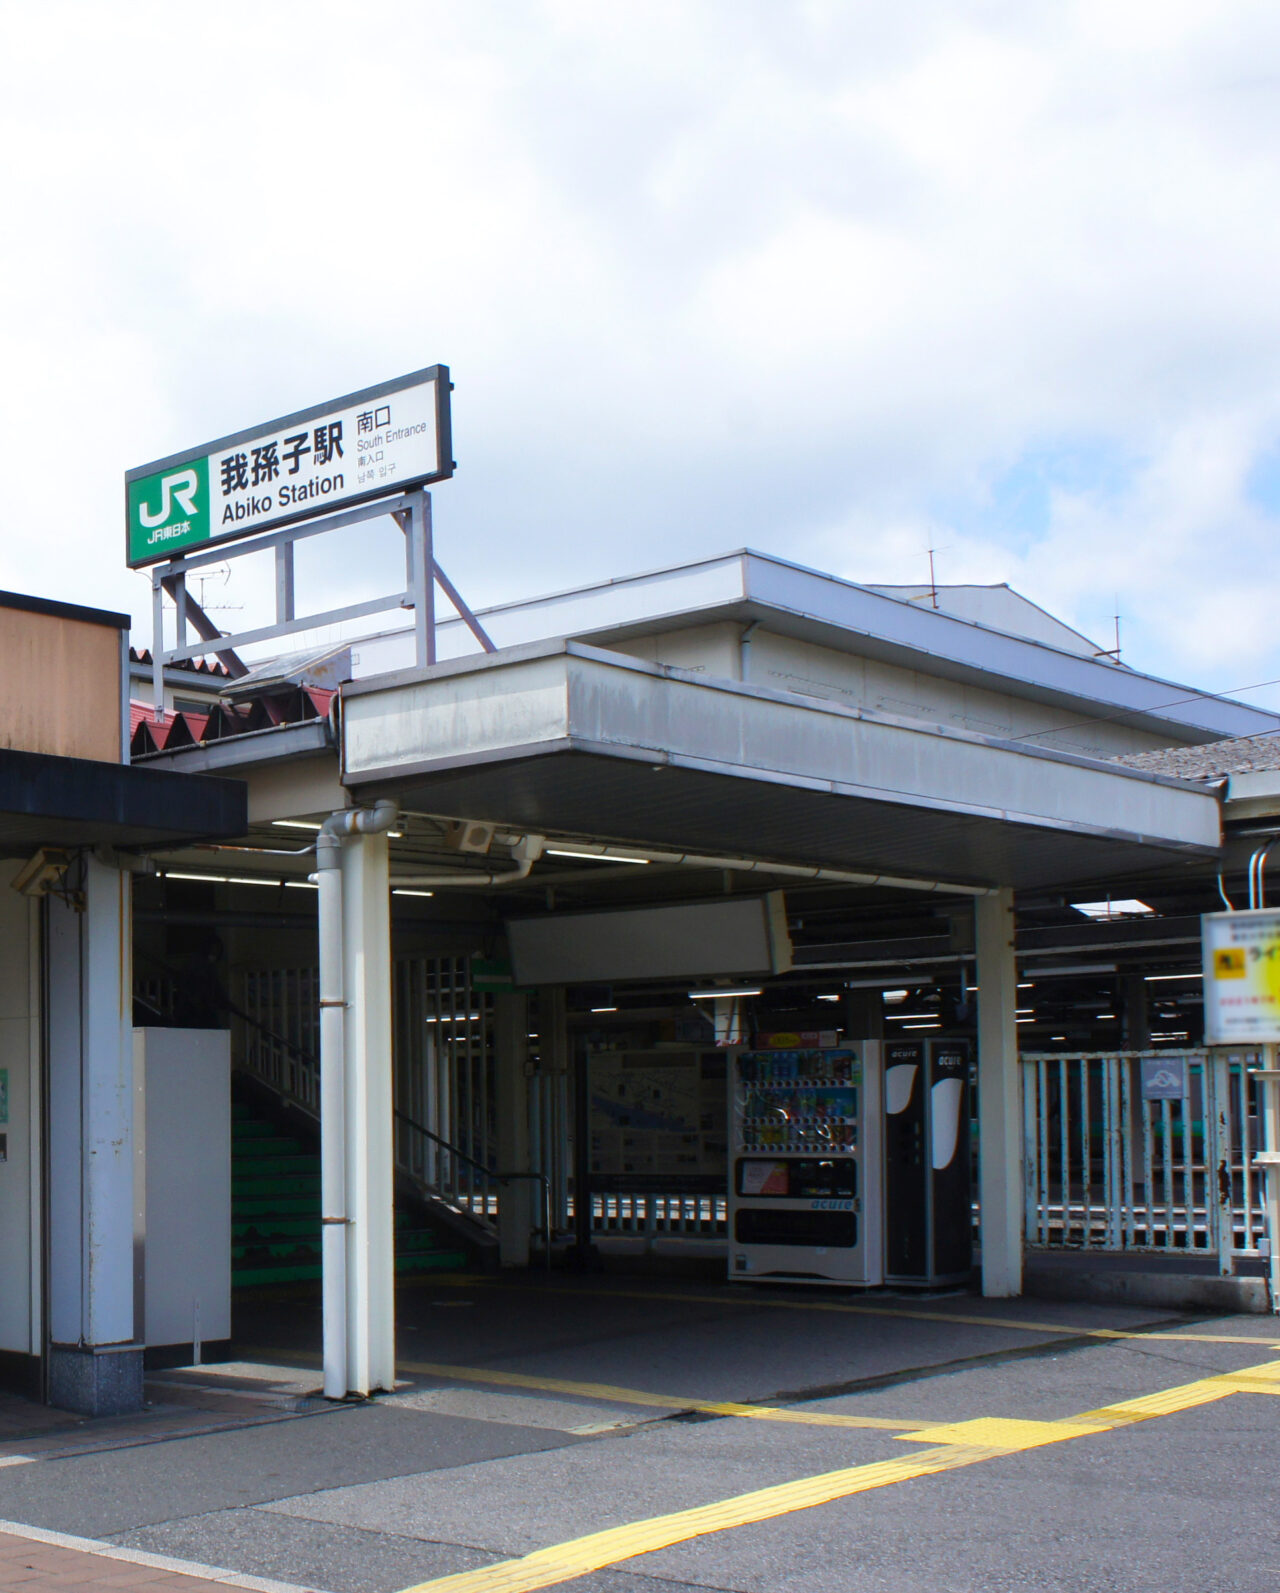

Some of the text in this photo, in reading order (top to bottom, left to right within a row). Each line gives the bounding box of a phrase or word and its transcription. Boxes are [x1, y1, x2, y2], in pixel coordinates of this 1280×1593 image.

[356, 406, 391, 435] 南口
[356, 422, 427, 452] South Entrance
[221, 421, 344, 496] 我孫子駅
[139, 469, 198, 528] JR
[222, 473, 344, 524] Abiko Station
[147, 520, 191, 545] JR東日本
[811, 1199, 853, 1210] acure
